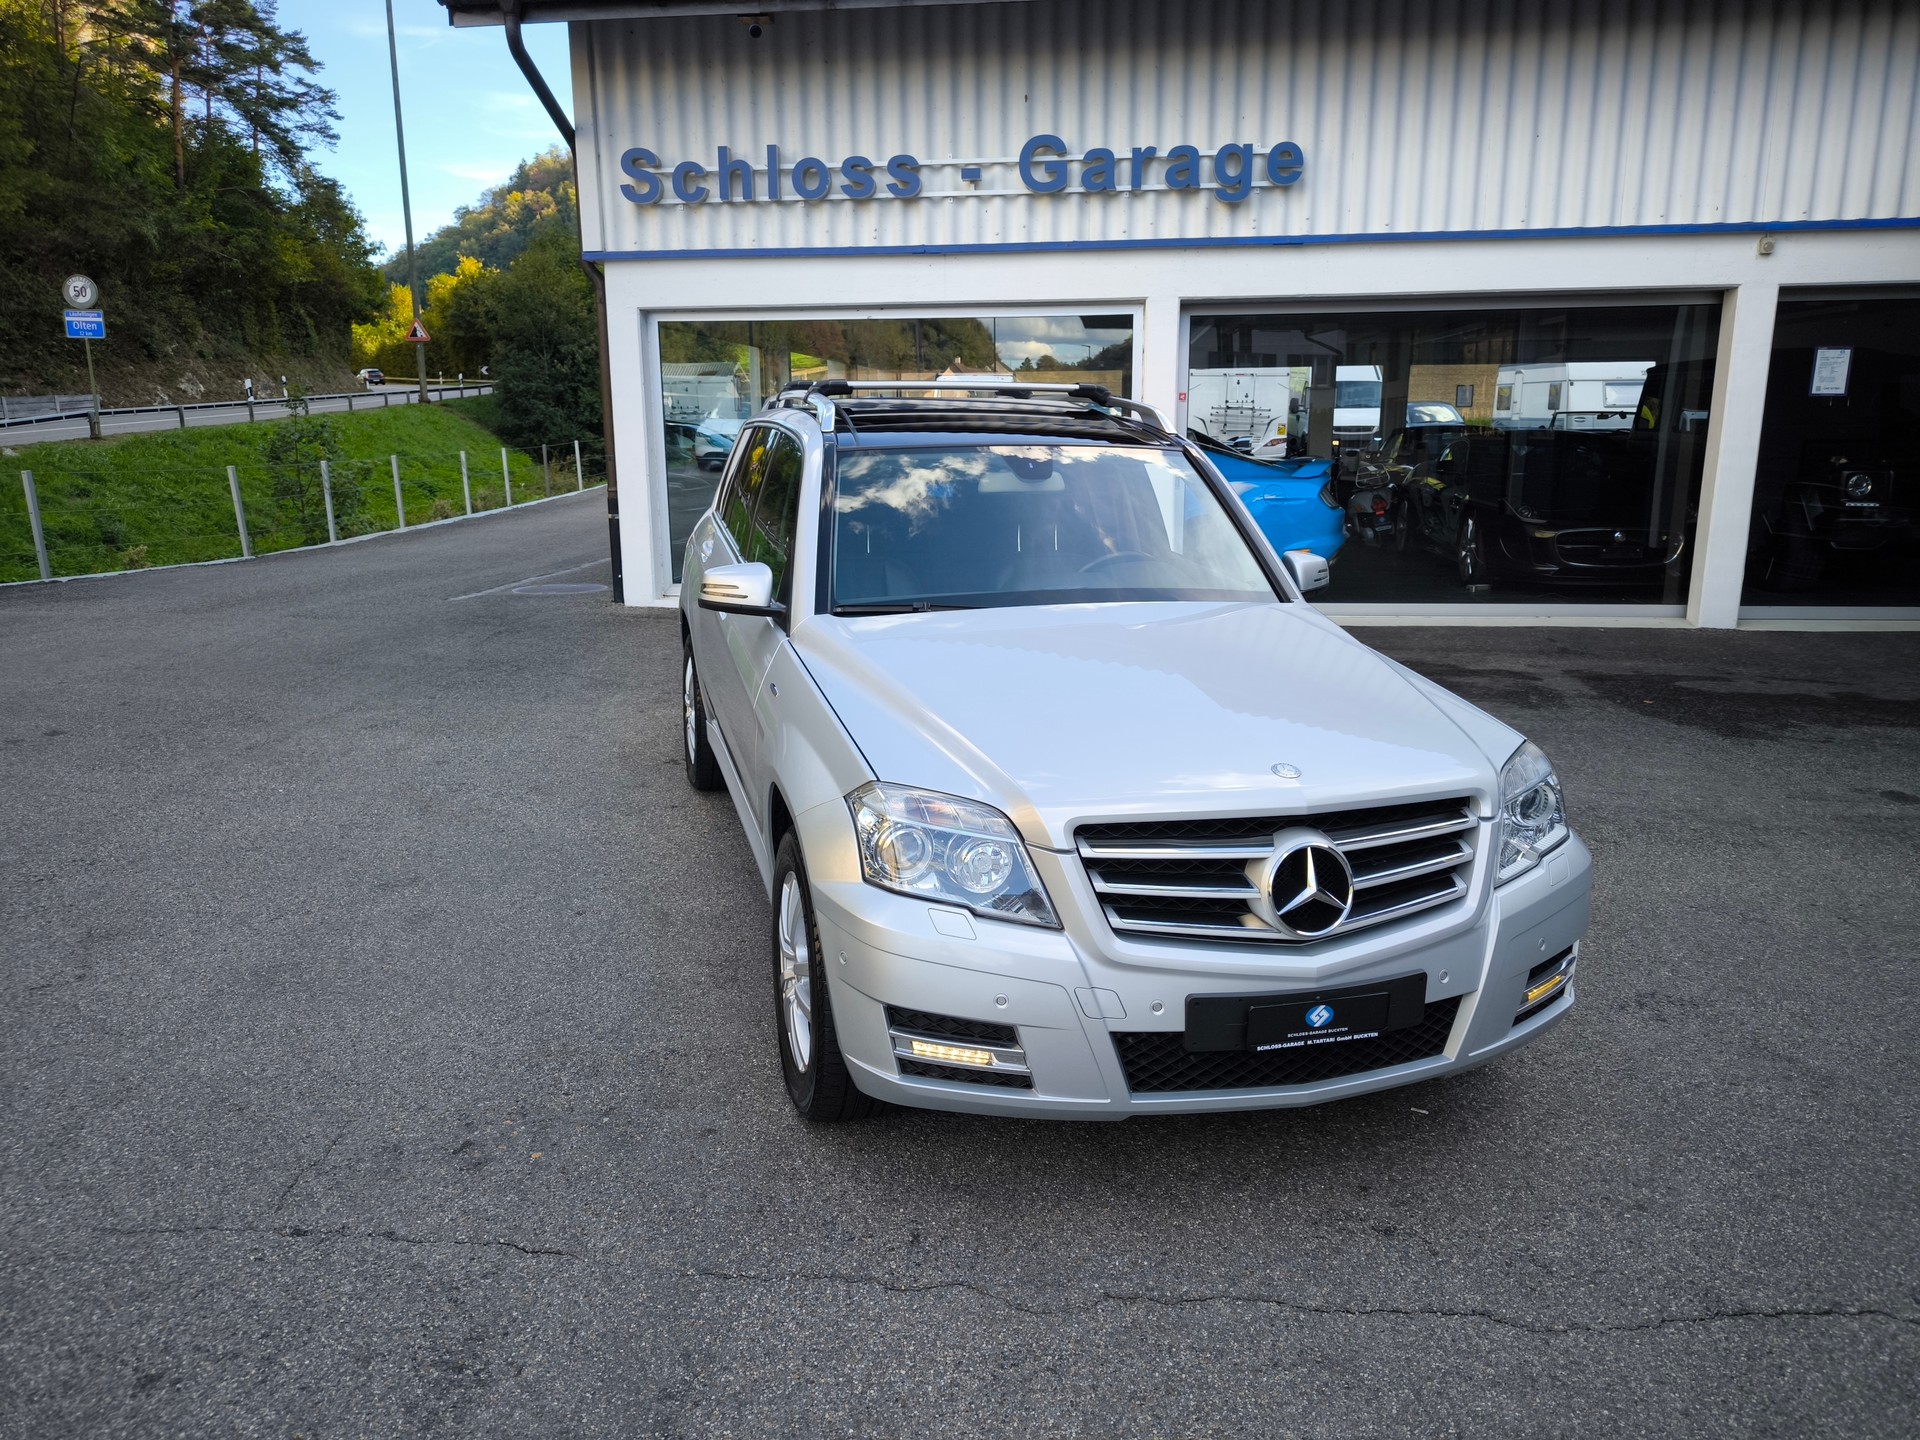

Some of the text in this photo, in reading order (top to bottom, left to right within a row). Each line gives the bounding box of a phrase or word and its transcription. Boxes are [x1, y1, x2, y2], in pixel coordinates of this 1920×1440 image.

[620, 134, 1304, 206] Schloss - Garage
[73, 285, 87, 298] 50
[72, 321, 97, 330] Olten
[1287, 1029, 1327, 1038] SCHLOSS-GARAGE
[1257, 1040, 1305, 1051] SCHLOSS-GARAGE
[1307, 1037, 1335, 1045] M.TARTARI
[1353, 1032, 1379, 1040] BUCKTEN
